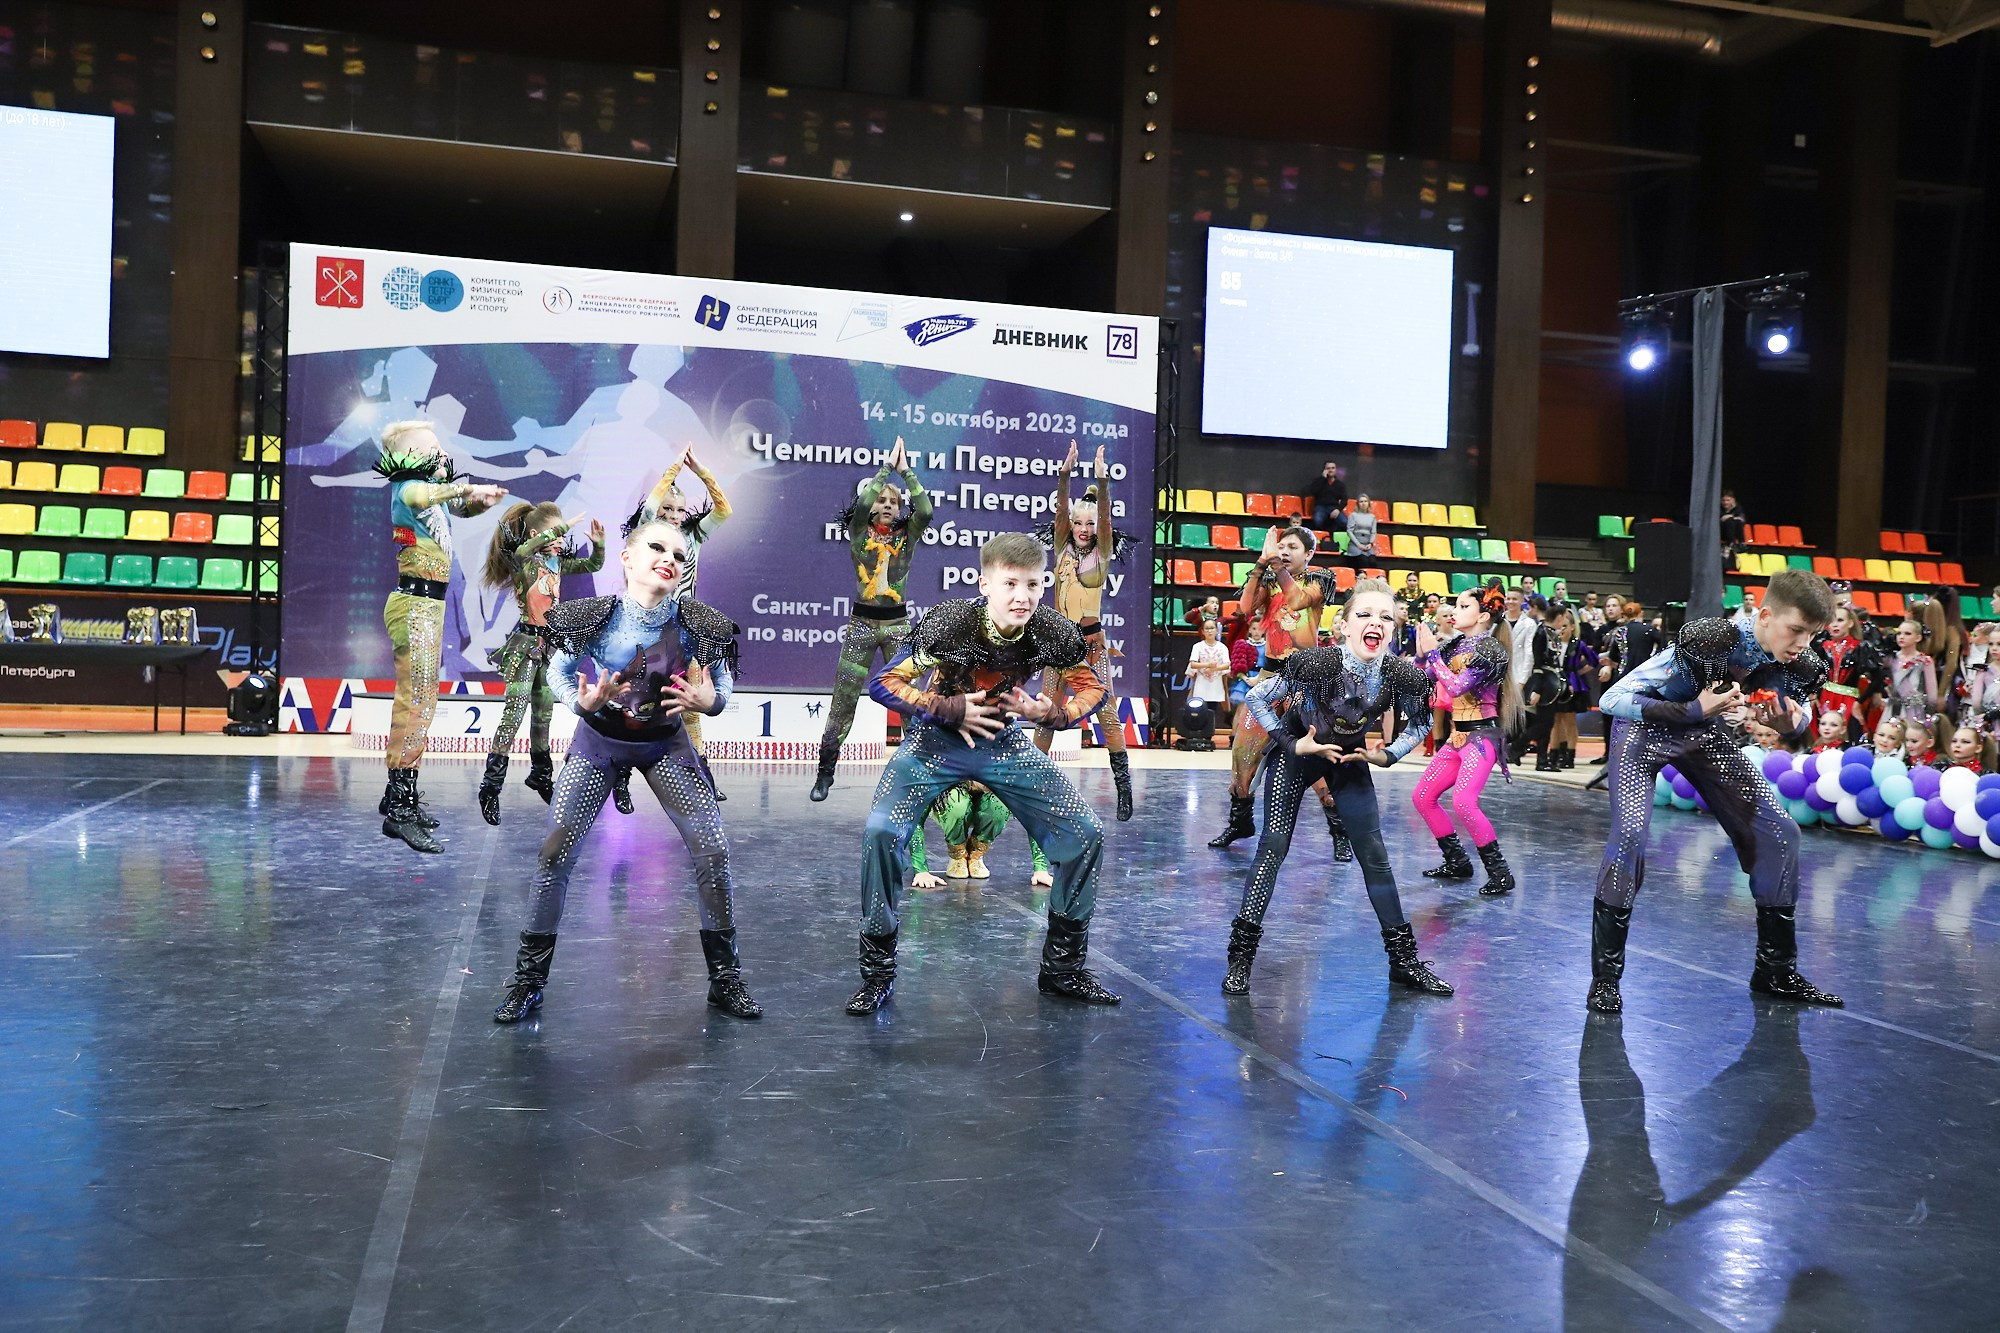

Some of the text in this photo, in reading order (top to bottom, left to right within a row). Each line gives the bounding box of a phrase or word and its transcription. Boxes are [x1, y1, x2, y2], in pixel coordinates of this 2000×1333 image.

[6, 110, 66, 130] (до 18 лет)
[429, 276, 454, 287] САНКТ
[471, 277, 507, 287] КОМИТЕТ
[1220, 271, 1242, 291] 85
[428, 286, 455, 296] ПЕТЕР
[471, 286, 523, 296] ФИЗИЧЕСКОЙ
[428, 295, 450, 305] БУРГ
[471, 295, 506, 304] КУЛЬТУРЕ
[582, 294, 637, 302] ВСЕРОССИЙСКАЯ
[478, 305, 509, 313] СПОРТУ
[577, 306, 637, 315] АКРОБАТИЧЕСКОГО
[580, 300, 641, 309] ТАНЦЕВАЛЬНОГО
[736, 305, 818, 316] САНКТ-ПЕТЕРБУРГСКАЯ
[736, 314, 817, 330] ФЕДЕРАЦИЯ
[992, 328, 1088, 351] ДНЕВНИК
[1112, 333, 1132, 351] 78
[860, 401, 886, 422] 14
[902, 403, 926, 424] 15
[930, 409, 1021, 434] октября
[1025, 411, 1077, 435] 2023
[1081, 420, 1129, 440] года
[752, 432, 922, 468] Чемпионт
[928, 451, 946, 470] и
[747, 626, 776, 642] по
[0, 665, 76, 679] Петербурга
[464, 706, 482, 734] 2
[757, 700, 776, 738] 1
